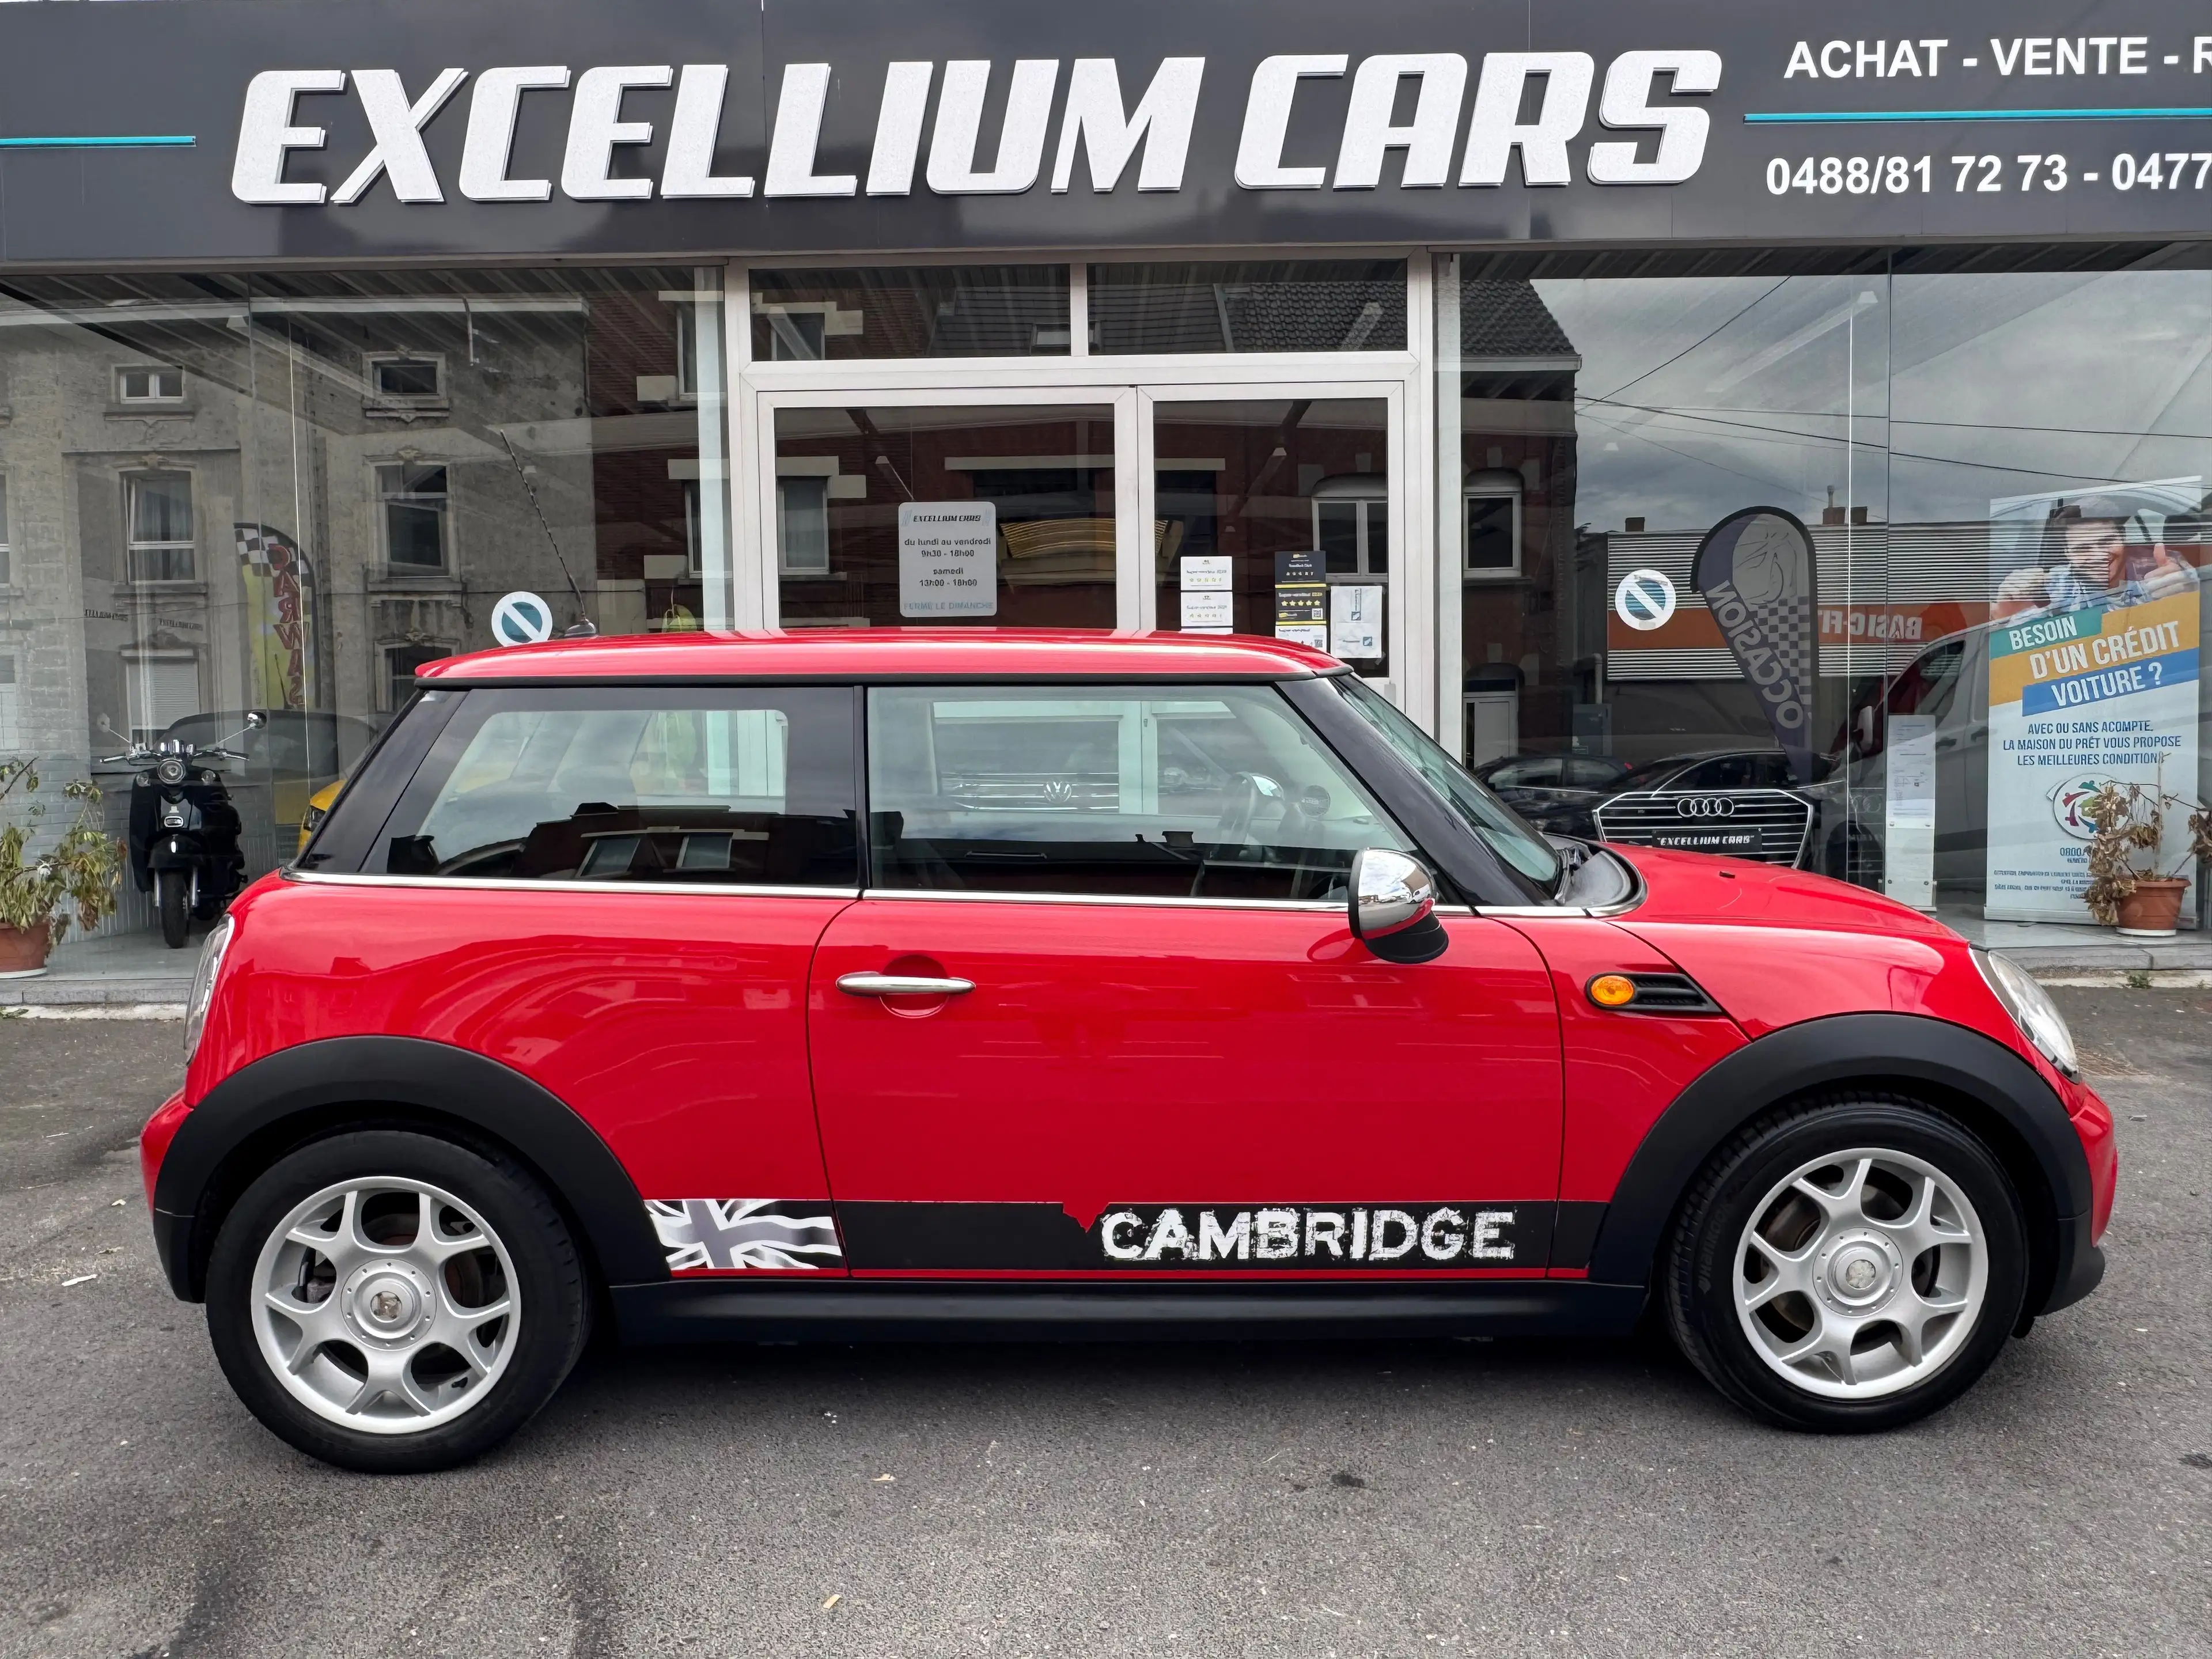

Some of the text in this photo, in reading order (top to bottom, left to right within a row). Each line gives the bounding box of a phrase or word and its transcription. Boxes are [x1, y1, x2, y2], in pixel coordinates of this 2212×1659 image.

[1783, 39, 1948, 79] ACHAT
[1990, 37, 2148, 75] VENTE
[232, 51, 1722, 203] EXCELLIUM CARS
[1766, 156, 1931, 195] 0488/81
[1951, 155, 2002, 192] 72
[2017, 154, 2068, 192] 73
[2112, 153, 2212, 191] 0477
[949, 601, 994, 610] DIMANCHE
[2009, 616, 2078, 650] BESOIN
[2030, 621, 2179, 679] D'UN CRÉDIT
[2051, 662, 2162, 707] VOITURE ?
[2003, 740, 2014, 751] LA
[2018, 738, 2056, 750] MAISON
[2059, 738, 2072, 749] DU
[2104, 737, 2130, 748] VOUS
[2134, 736, 2182, 748] PROPOSE
[2028, 723, 2053, 734] AVEC
[2056, 722, 2069, 734] OU
[2072, 721, 2099, 733] SANS
[2017, 755, 2035, 766] LES
[2038, 754, 2100, 765] MEILLEURES
[1101, 1207, 1516, 1261] CAMBRIDGE
